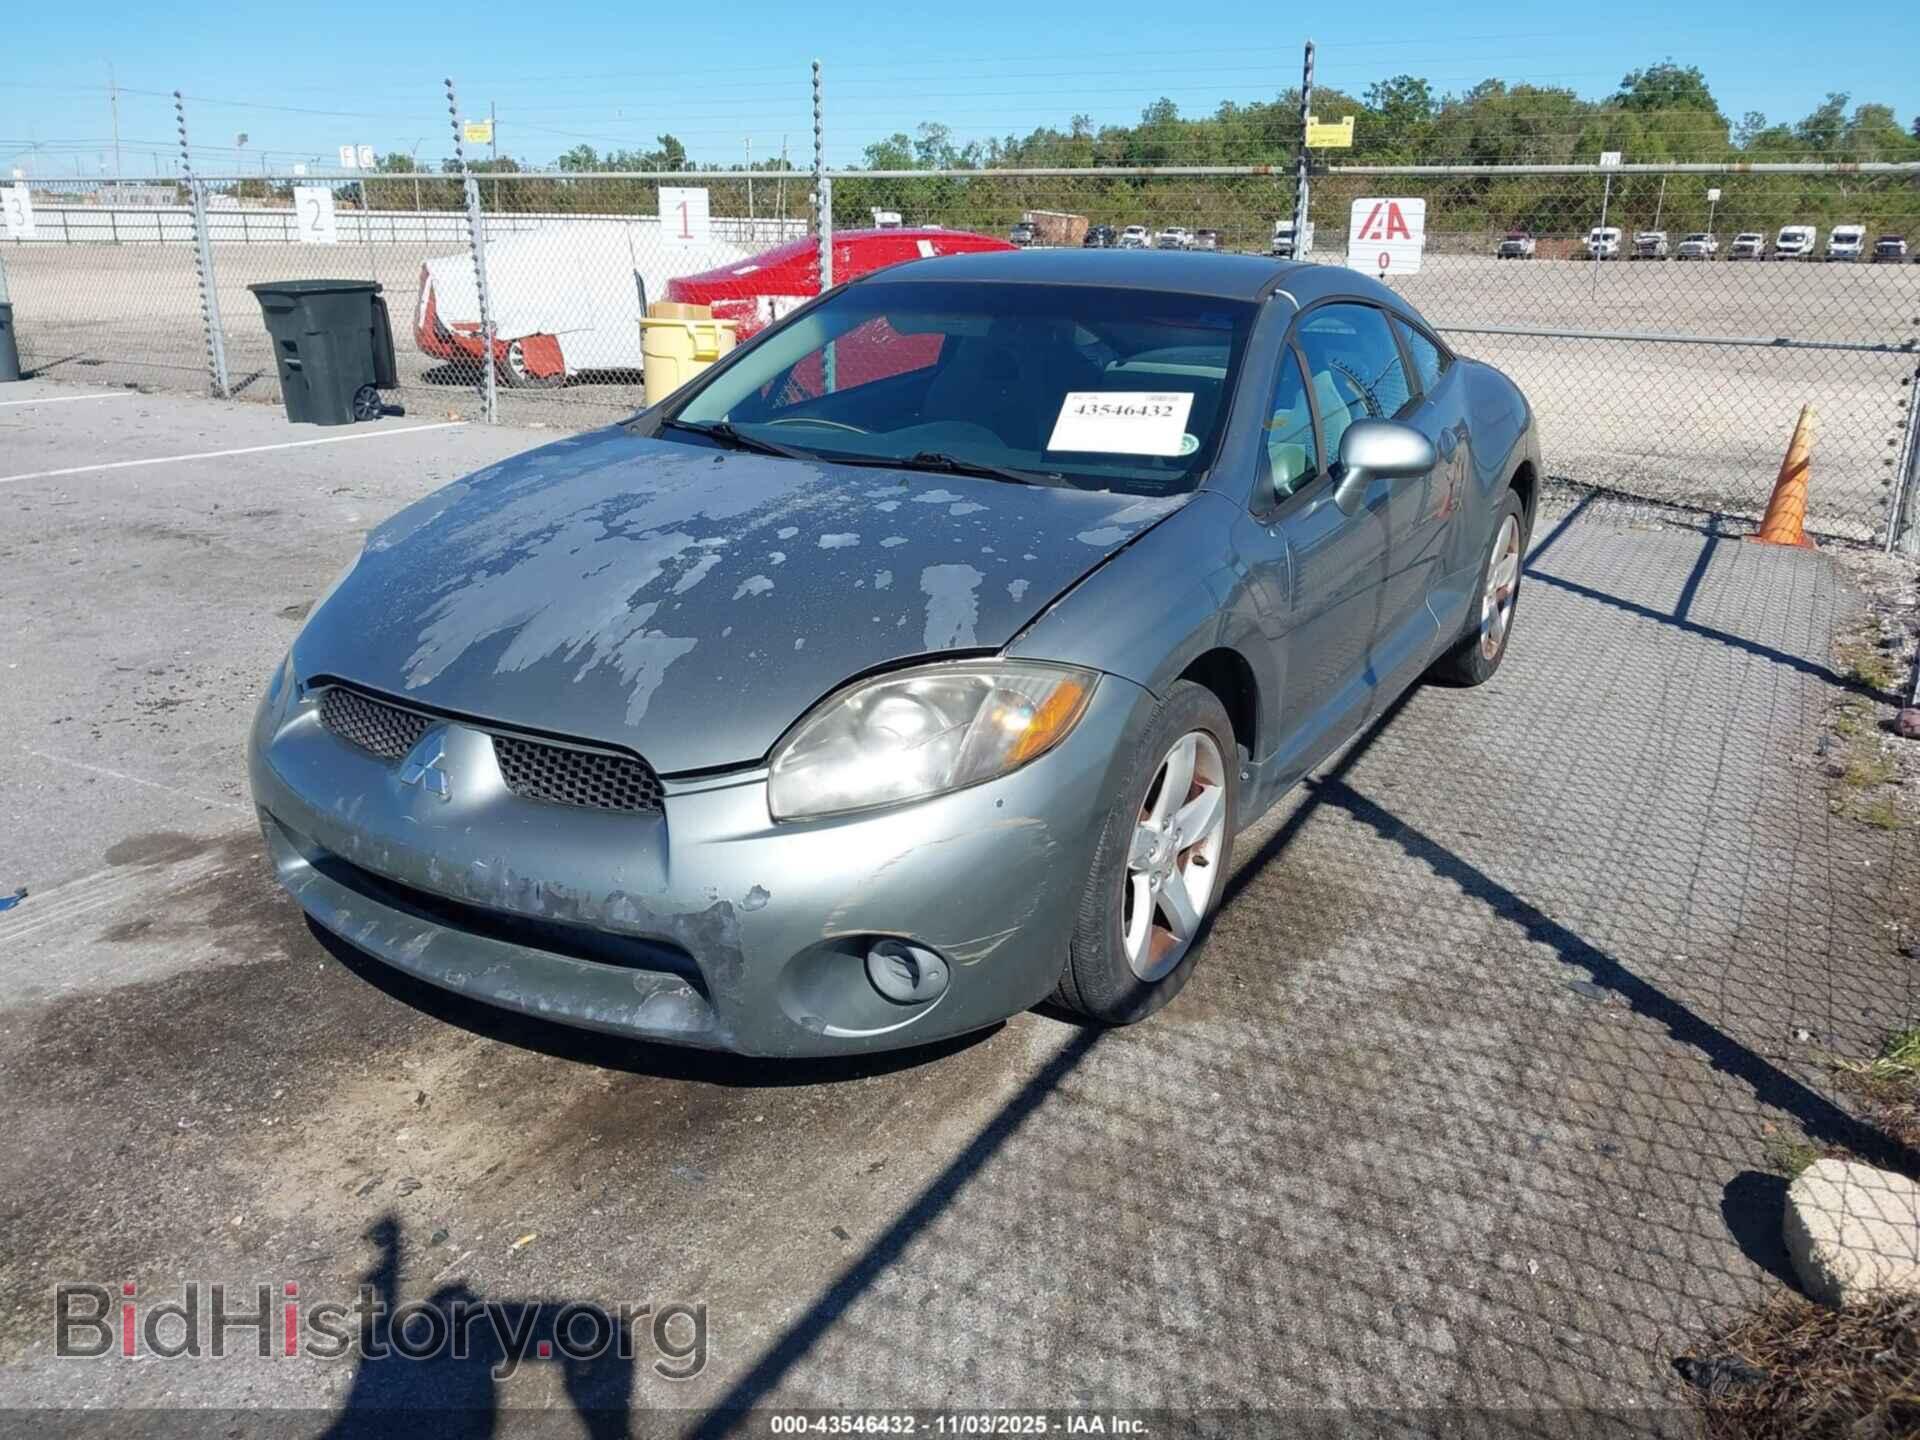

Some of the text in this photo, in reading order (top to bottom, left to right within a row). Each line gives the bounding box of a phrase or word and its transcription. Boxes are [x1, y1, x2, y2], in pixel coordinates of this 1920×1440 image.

[11, 198, 25, 226] 3
[306, 199, 325, 231] 2
[676, 201, 694, 239] 1
[1378, 252, 1390, 269] 0
[1073, 404, 1173, 417] 43546432
